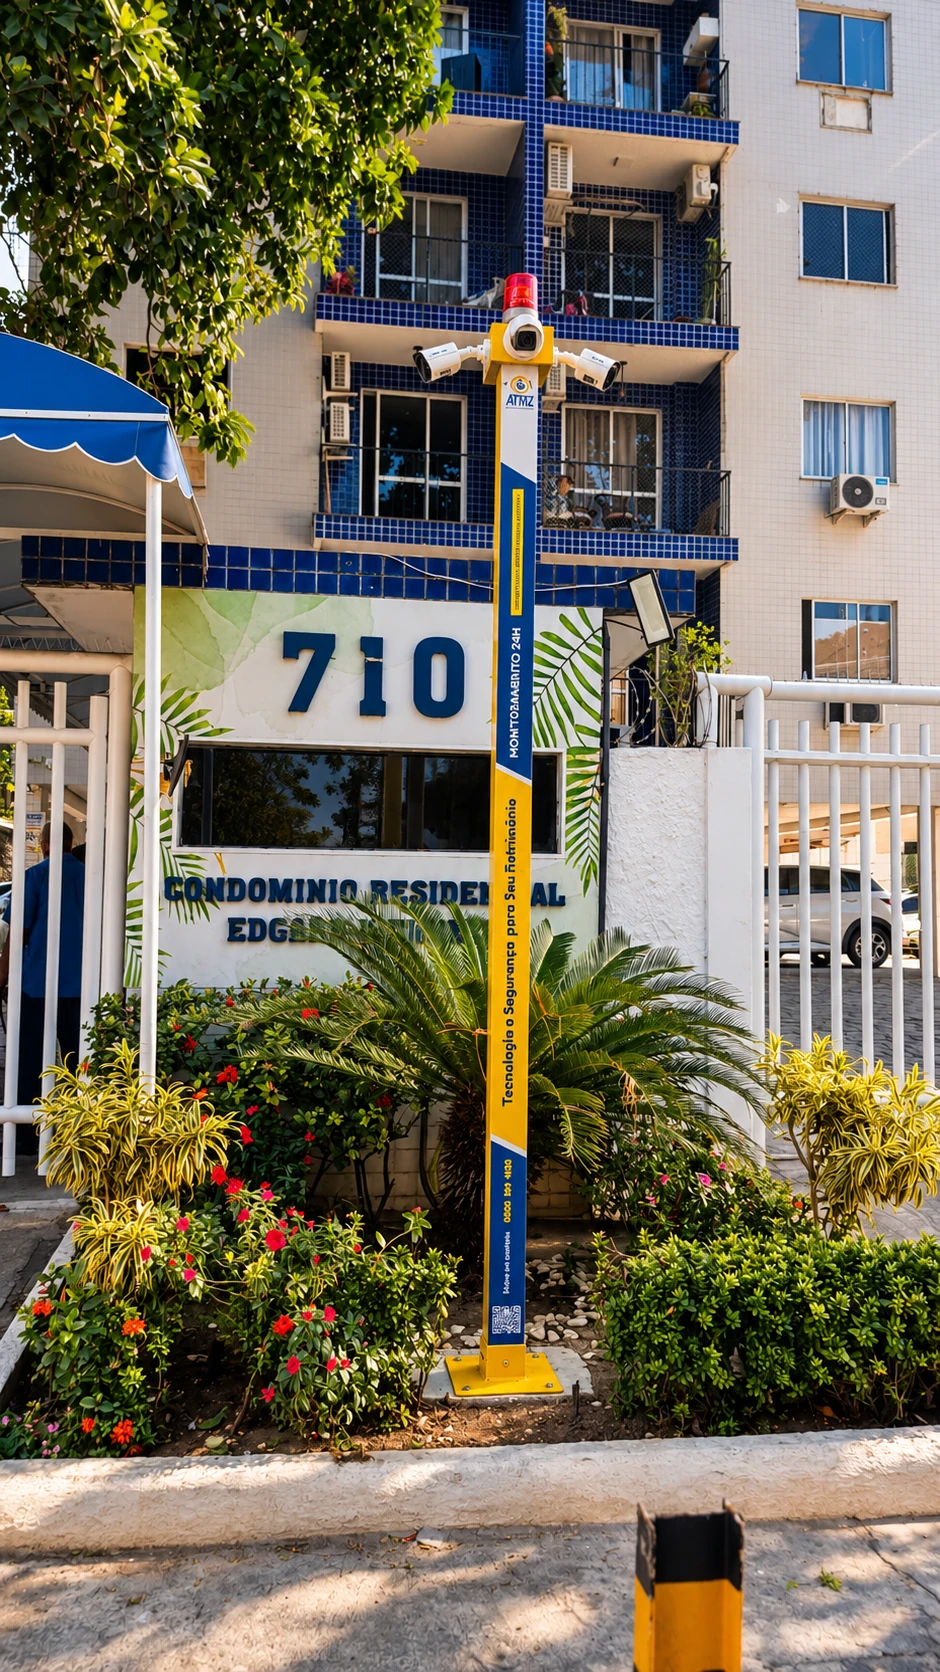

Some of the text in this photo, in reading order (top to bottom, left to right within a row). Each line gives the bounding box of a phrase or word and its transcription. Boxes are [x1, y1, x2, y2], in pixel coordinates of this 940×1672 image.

[506, 393, 534, 407] ATMZ
[511, 627, 521, 651] 24H
[282, 631, 466, 718] 710
[163, 876, 358, 903] CONDOMINIO
